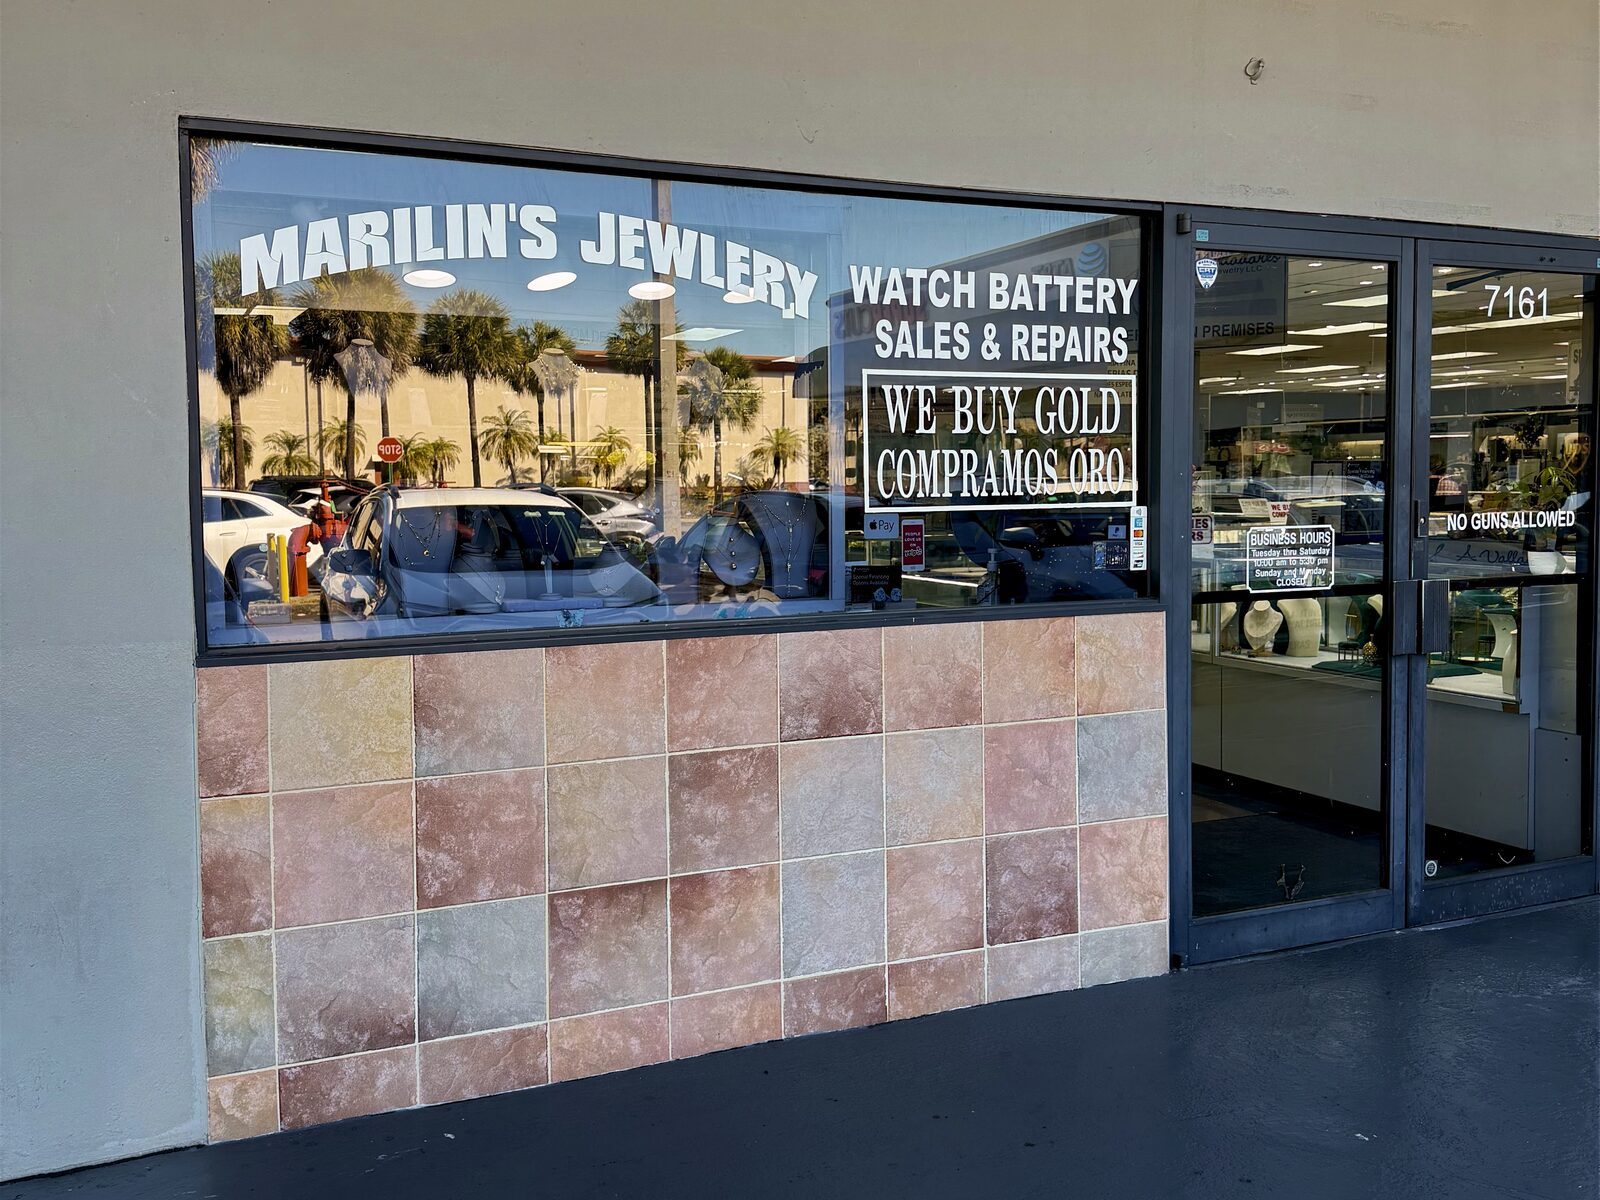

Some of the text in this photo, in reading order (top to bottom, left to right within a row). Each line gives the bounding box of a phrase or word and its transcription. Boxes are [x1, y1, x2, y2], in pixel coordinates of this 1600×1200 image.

[240, 203, 818, 320] MARILIN'S JEWLERY
[850, 265, 1138, 315] WATCH BATTERY
[1484, 285, 1548, 319] 7161
[1202, 322, 1275, 338] PREMISES
[875, 319, 970, 361] SALES
[981, 322, 1001, 361] &
[1012, 324, 1129, 363] REPAIRS
[882, 384, 1121, 435] WE BUY GOLD
[877, 448, 1125, 499] COMPRAMOS ORO
[878, 520, 895, 533] Pay
[1447, 511, 1576, 531] NO GUNS ALLOWED
[1250, 531, 1331, 546] BUSINESS HOURS
[1251, 547, 1330, 558] Tuesday thru Saturday
[1254, 559, 1273, 567] 10:00
[1299, 557, 1315, 565] 5:30
[1317, 558, 1329, 566] pm
[1255, 567, 1326, 578] Sunday and Monday
[1276, 578, 1305, 587] CLOSED
